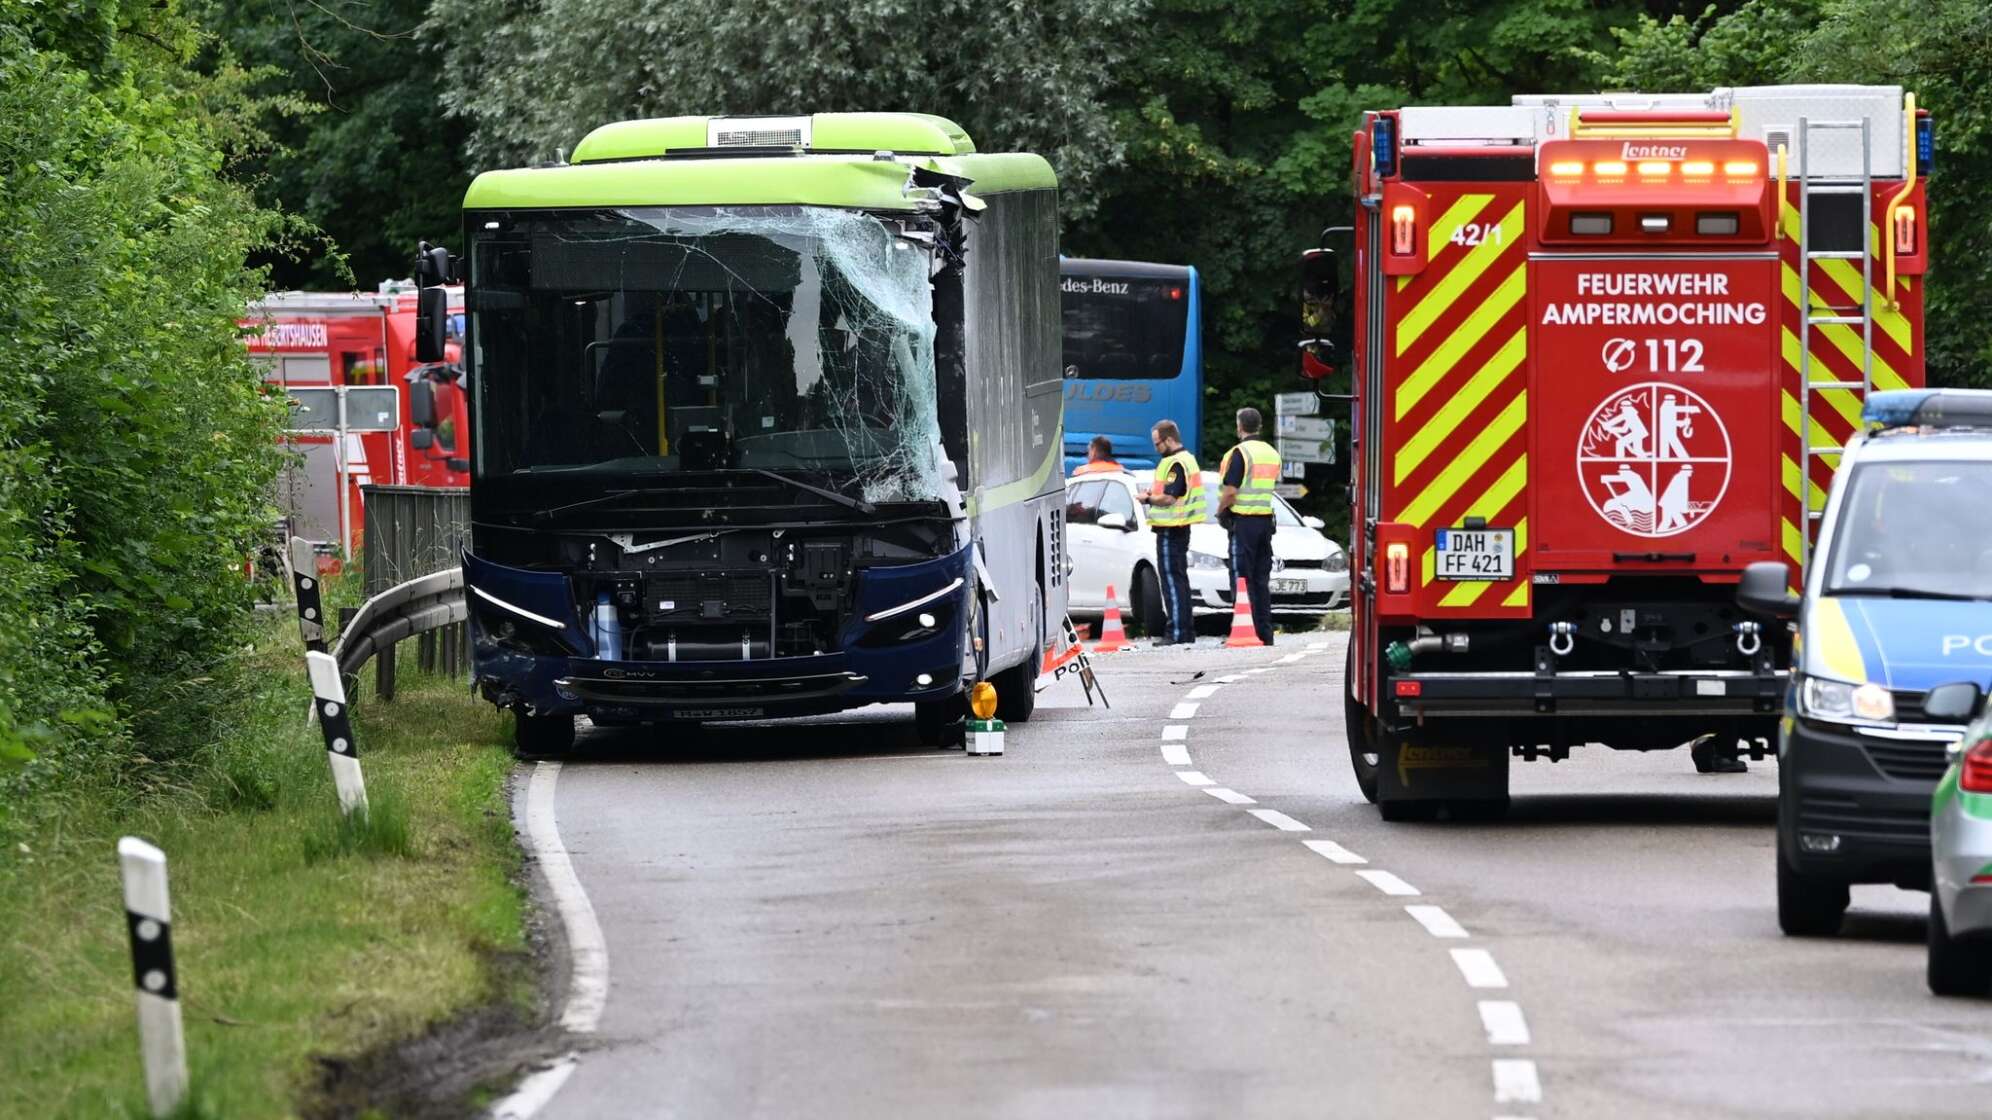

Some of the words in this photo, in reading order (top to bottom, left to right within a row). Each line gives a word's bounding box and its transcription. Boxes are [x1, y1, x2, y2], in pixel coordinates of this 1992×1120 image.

[1621, 141, 1687, 161] Lentner
[1450, 223, 1502, 246] 42/1
[1060, 278, 1129, 295] des-Benz
[1577, 273, 1729, 296] FEUERWEHR
[1541, 302, 1767, 325] AMPERMOCHING
[1645, 339, 1705, 372] 112
[1452, 533, 1486, 552] DAH
[1445, 554, 1467, 572] FF
[1471, 554, 1503, 573] 421
